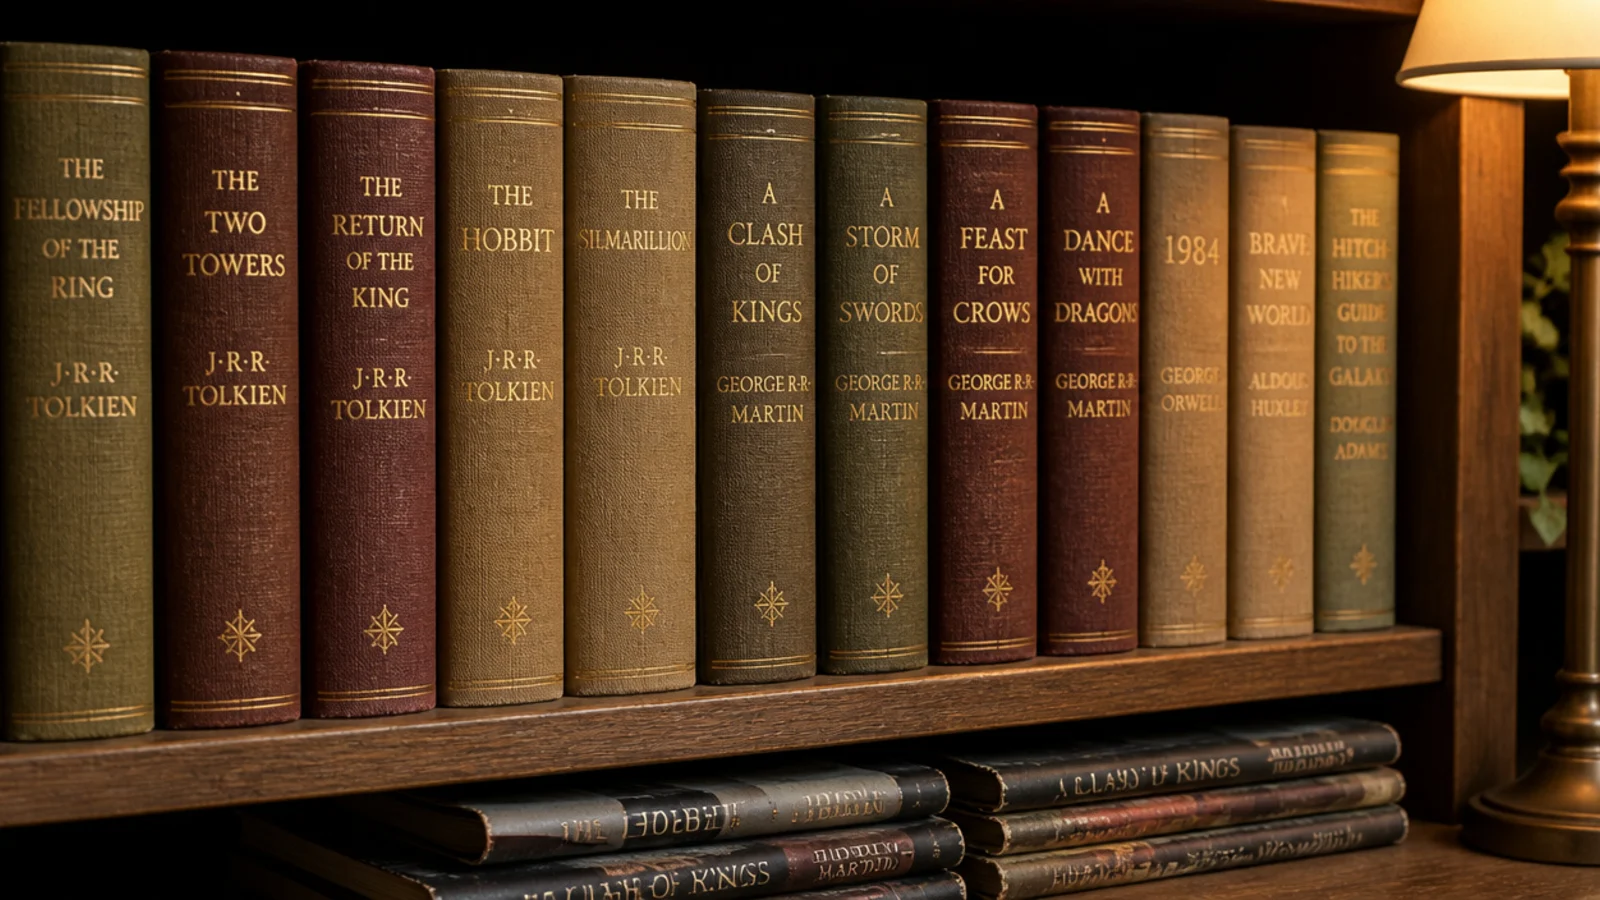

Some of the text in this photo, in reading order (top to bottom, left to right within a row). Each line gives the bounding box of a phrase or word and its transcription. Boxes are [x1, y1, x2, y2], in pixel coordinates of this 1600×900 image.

[59, 158, 104, 179] THE
[212, 169, 259, 192] THE
[360, 176, 402, 198] THE
[488, 184, 533, 206] THE
[621, 189, 659, 210] THE
[762, 182, 778, 204] A
[880, 187, 894, 207] A
[990, 189, 1005, 210] A
[1096, 192, 1110, 214] A
[13, 198, 145, 221] FELLOWSHIP
[1349, 208, 1380, 227] THE
[204, 210, 267, 235] TWO
[332, 214, 424, 238] RETURN
[461, 227, 555, 253] HOBBIT
[577, 229, 692, 252] SILMARILLION
[727, 222, 803, 246] CLASH
[846, 226, 920, 249] STORM
[960, 227, 1028, 250] FEAST
[1063, 229, 1134, 253] DANCE
[42, 239, 120, 259] OF THE
[1165, 235, 1220, 266] 1984
[182, 253, 286, 277] TOWERS
[346, 252, 414, 271] OF THE
[755, 263, 782, 283] OF
[873, 264, 899, 285] OF
[978, 266, 1015, 285] FOR
[1079, 267, 1123, 286] WITH
[1259, 267, 1302, 290] NEW
[50, 276, 114, 299] RING
[352, 286, 410, 309] KING
[732, 300, 803, 323] KINGS
[839, 301, 924, 324] SWORDS
[953, 301, 1031, 324] CROWS
[1054, 301, 1138, 324] DRAGONS
[1246, 304, 1312, 326] WORLD
[1337, 303, 1387, 322] GUIDE
[1336, 334, 1387, 354] TO THE
[461, 380, 554, 401] TOLKIEN
[593, 376, 682, 397] TOLKIEN
[716, 375, 785, 393] GEORGE
[836, 374, 900, 392] GEORGE
[948, 374, 1011, 392] GEORGE
[1056, 373, 1116, 390] GEORGE
[183, 384, 287, 406] TOLKIEN
[28, 396, 137, 417] TOLKIEN
[331, 399, 427, 420] TOLKIEN
[731, 405, 804, 423] MARTIN
[850, 402, 919, 421] MARTIN
[960, 401, 1028, 421] MARTIN
[1067, 399, 1131, 418] MARTIN
[1176, 757, 1240, 784] KINGS
